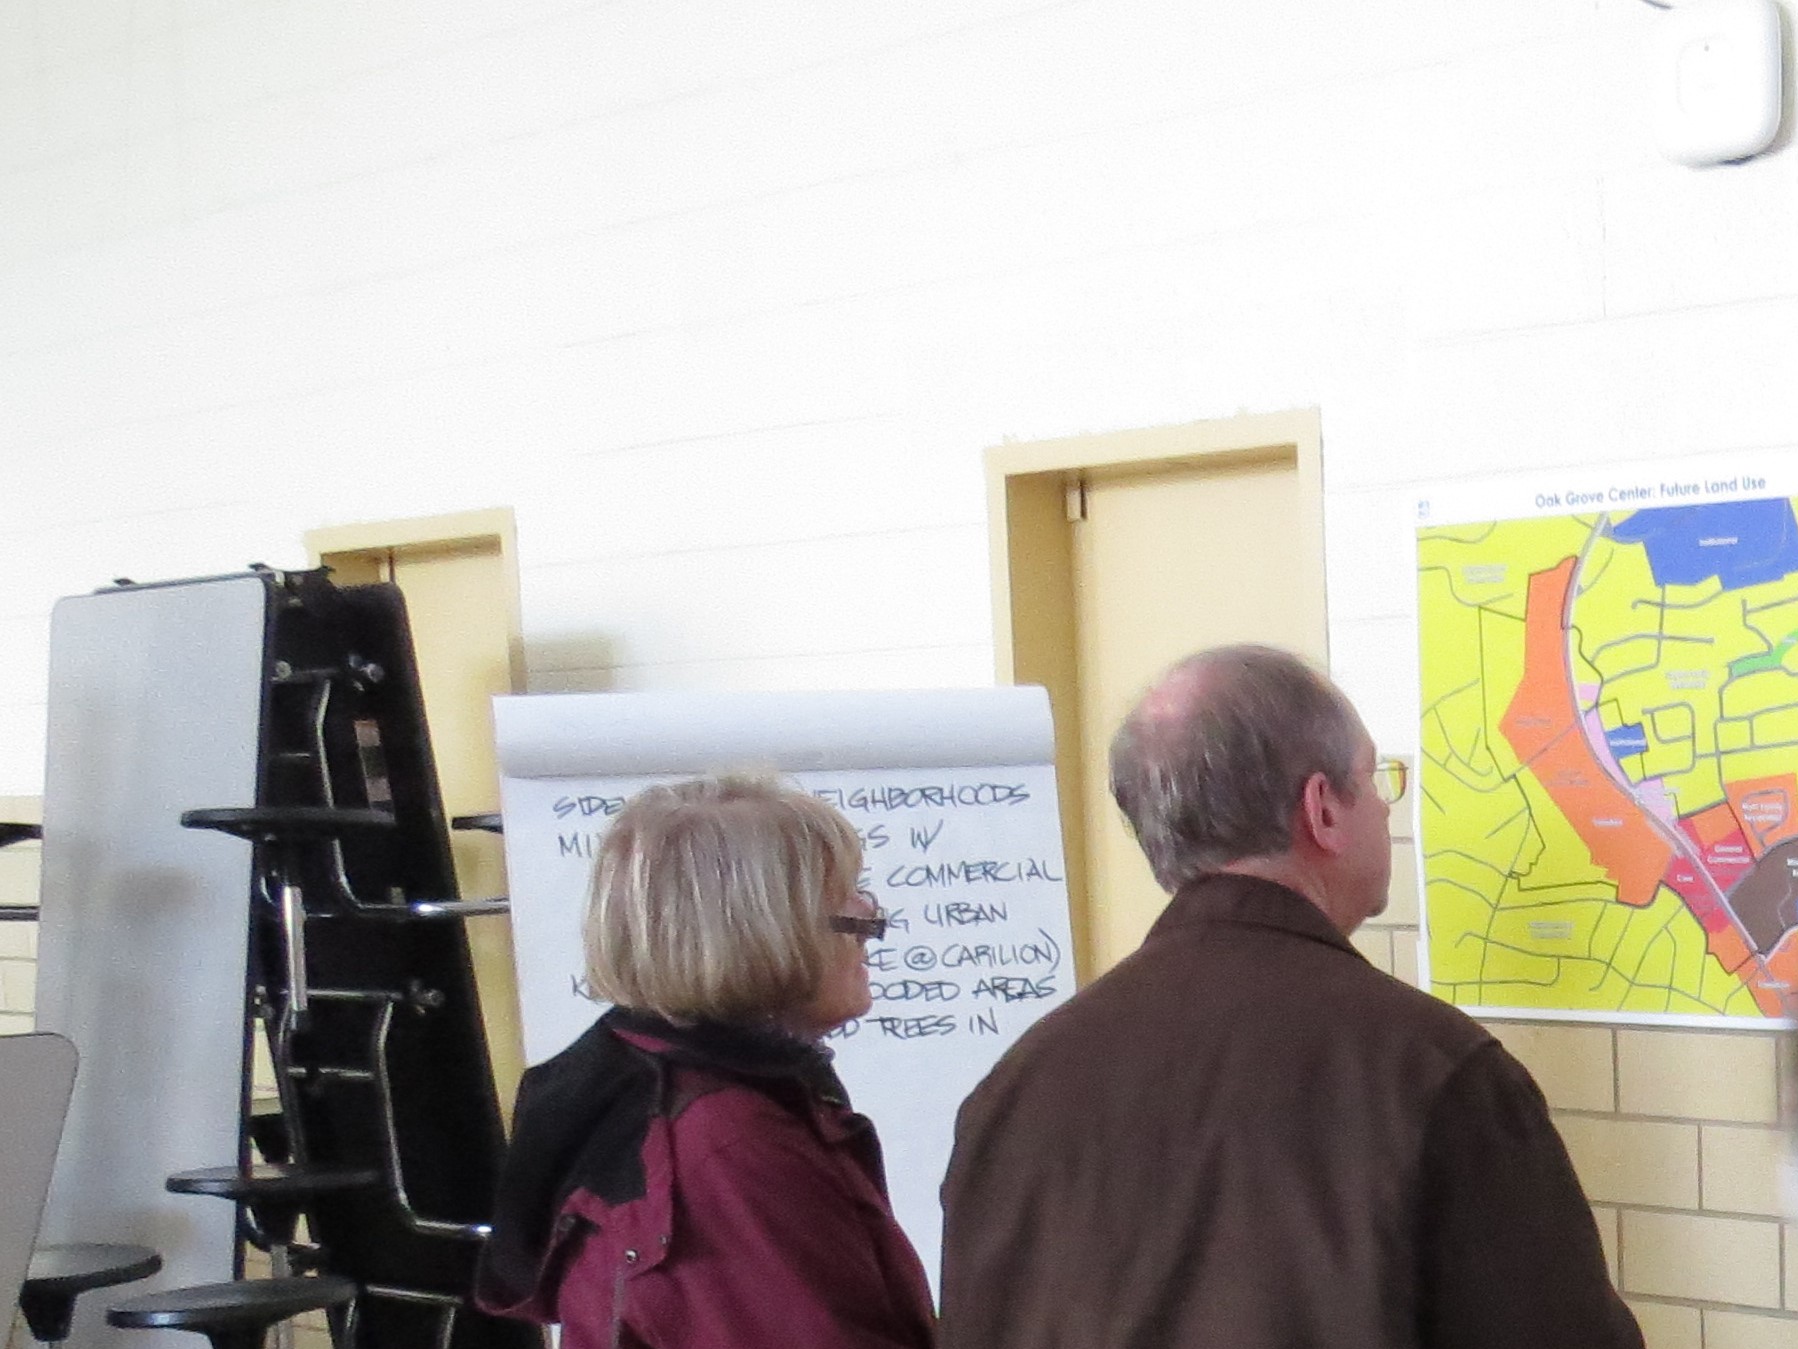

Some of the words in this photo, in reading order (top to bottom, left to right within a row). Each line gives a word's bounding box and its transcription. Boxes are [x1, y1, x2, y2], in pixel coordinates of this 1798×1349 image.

[1534, 493, 1562, 508] Oak
[1565, 488, 1606, 506] Grove
[1608, 485, 1657, 503] Center:
[1659, 482, 1701, 499] Future
[1704, 478, 1740, 495] Land
[1742, 476, 1767, 492] Use
[552, 796, 626, 820] SIDE
[812, 783, 1031, 812] EIGHBORHOODS
[886, 857, 1063, 888] COMMERCIAL
[924, 899, 1008, 928] URBAN
[868, 979, 961, 1002] OODED
[971, 975, 1058, 1004] AREAS
[864, 1014, 957, 1040] TREES
[968, 1007, 999, 1036] IN
